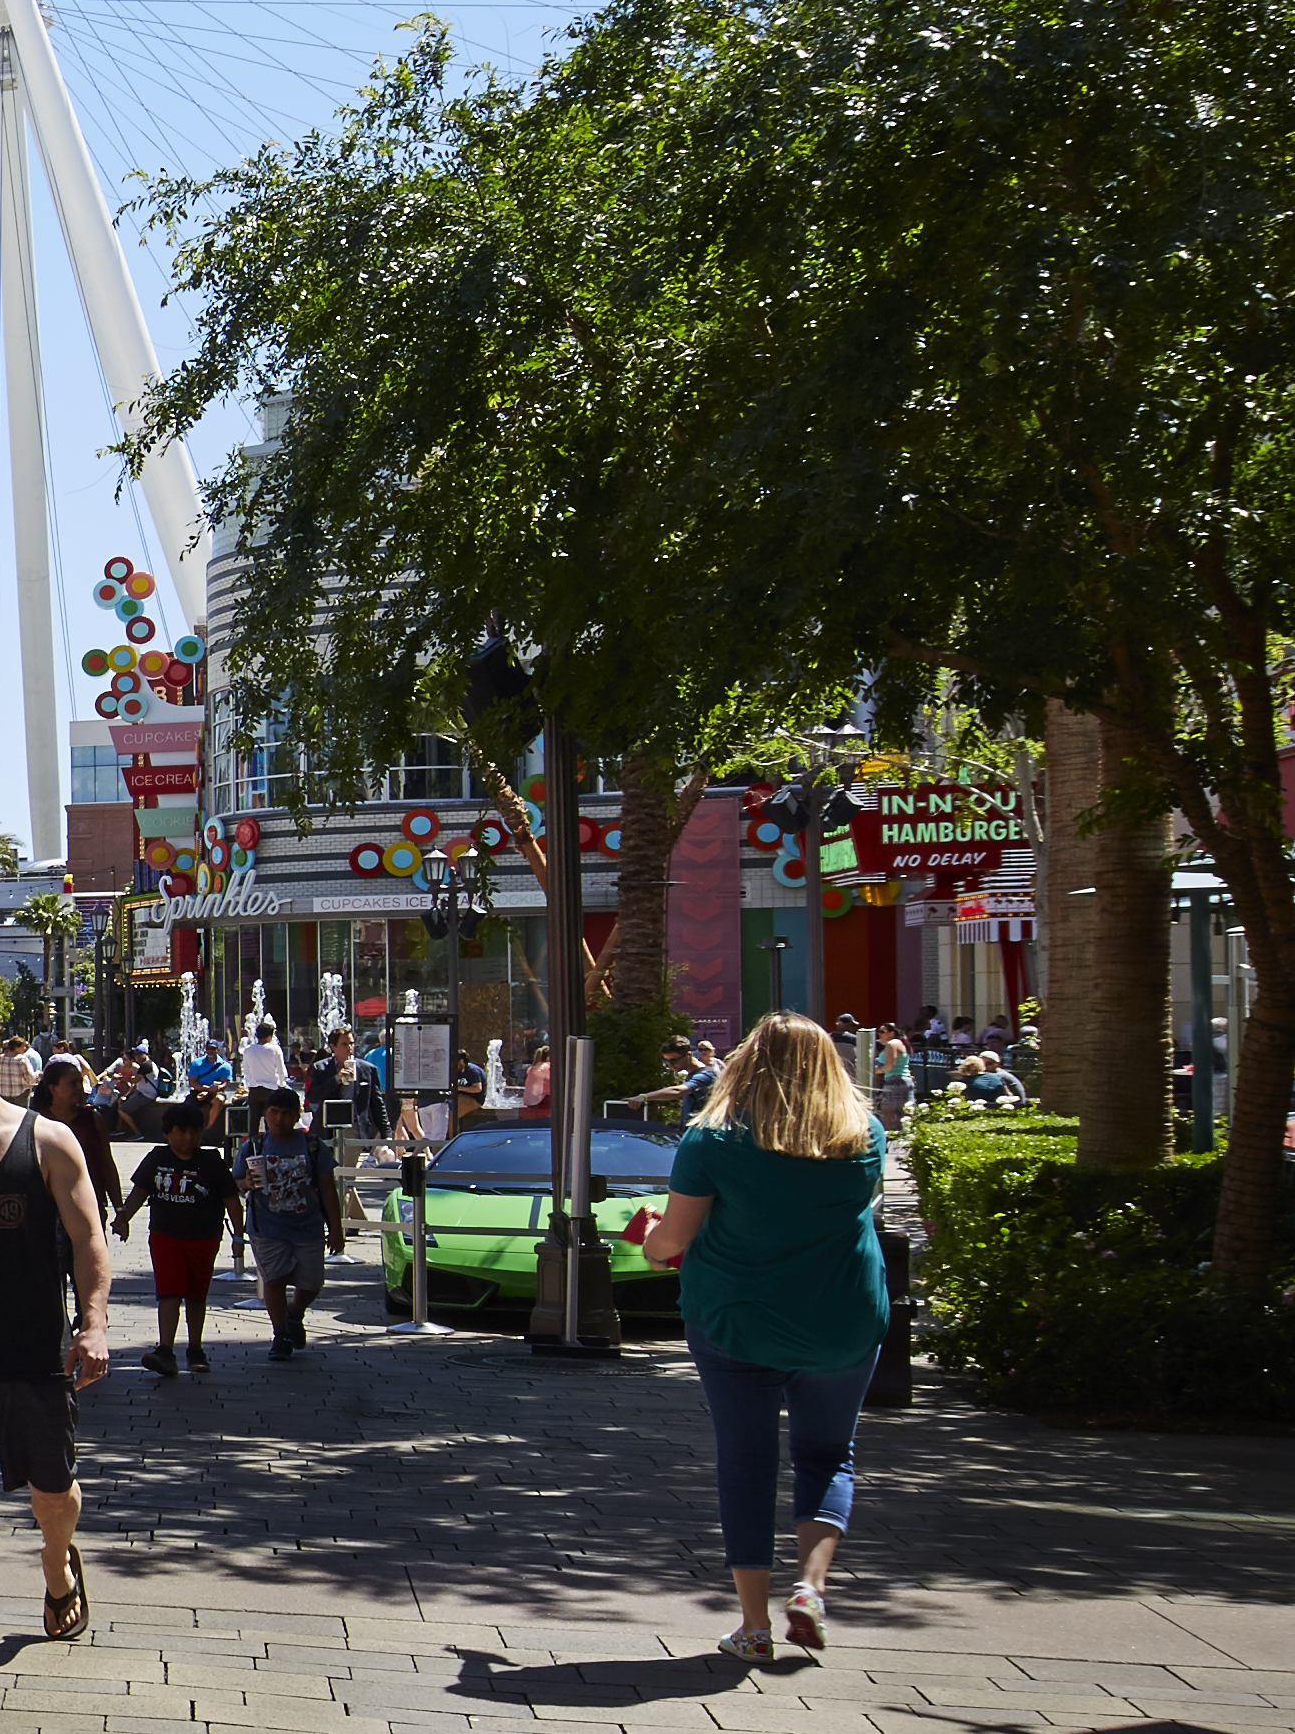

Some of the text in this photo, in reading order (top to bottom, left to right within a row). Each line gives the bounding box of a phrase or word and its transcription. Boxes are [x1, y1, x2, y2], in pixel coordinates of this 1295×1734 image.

[131, 773, 193, 786] ICE CREA
[881, 791, 1017, 816] IN-N-OU
[142, 816, 194, 828] COOKIE
[882, 820, 1029, 845] HAMBURGE
[893, 851, 987, 868] NO DELAY
[152, 869, 292, 935] Sprinkles
[320, 898, 401, 911] CUPCAKES
[405, 897, 428, 908] ICE
[497, 892, 546, 907] OOKIE
[170, 1194, 196, 1204] VEGAS
[1, 1202, 18, 1221] 49
